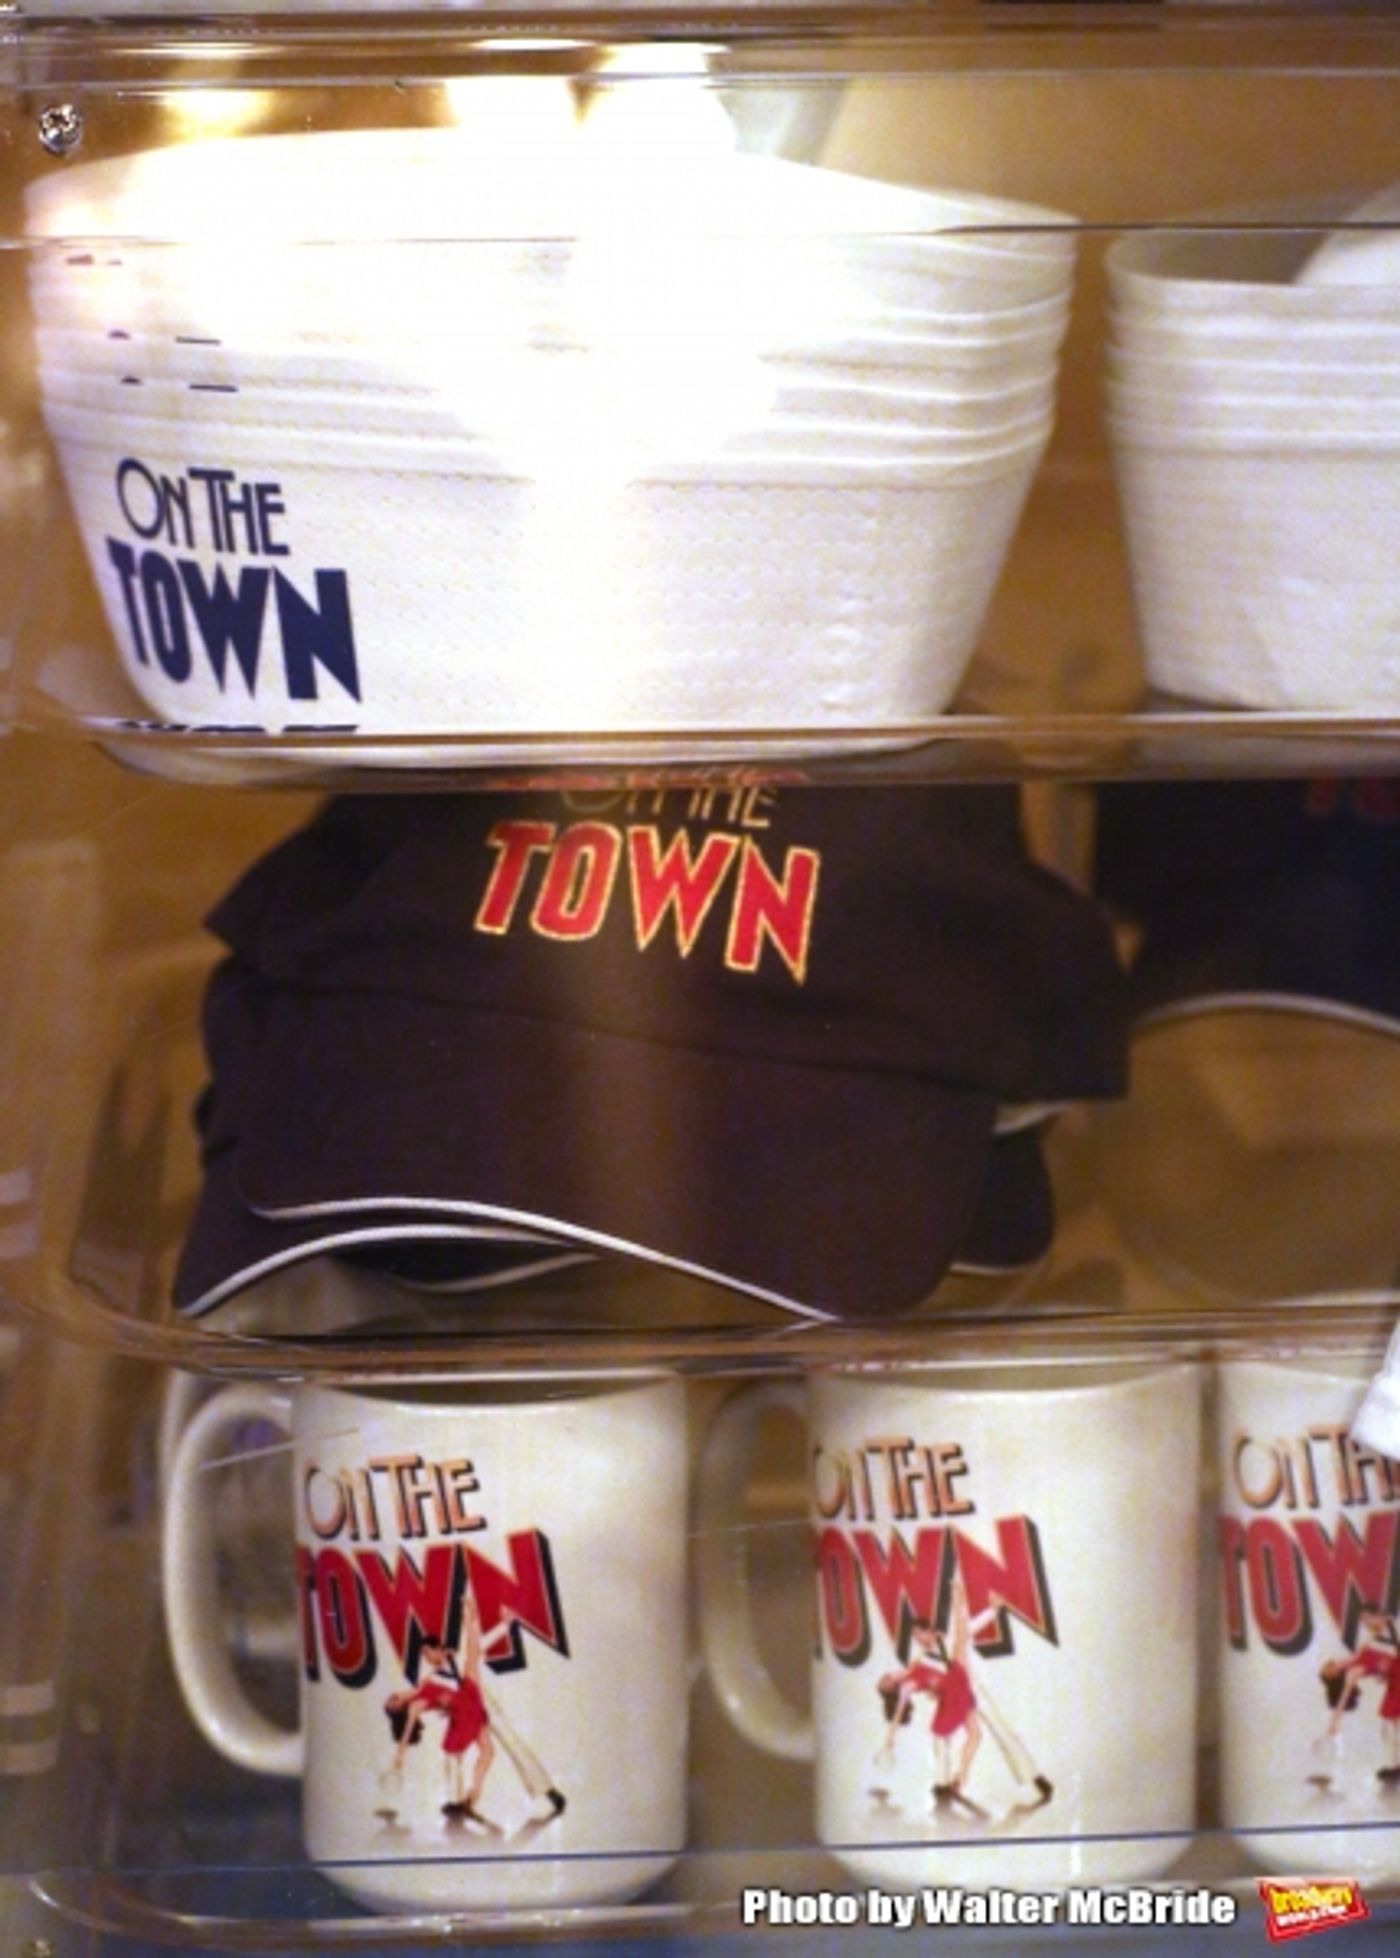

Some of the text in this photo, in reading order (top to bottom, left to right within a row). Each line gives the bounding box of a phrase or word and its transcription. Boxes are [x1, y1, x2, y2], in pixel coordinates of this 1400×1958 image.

[116, 458, 291, 556] ON THE
[106, 535, 362, 703] TOWN
[474, 820, 821, 986] TOWN
[305, 1454, 488, 1541] ON THE
[864, 1436, 976, 1519] THE
[1233, 1422, 1400, 1510] ON TH
[812, 1514, 1060, 1668] OWN
[1218, 1510, 1400, 1658] TOW
